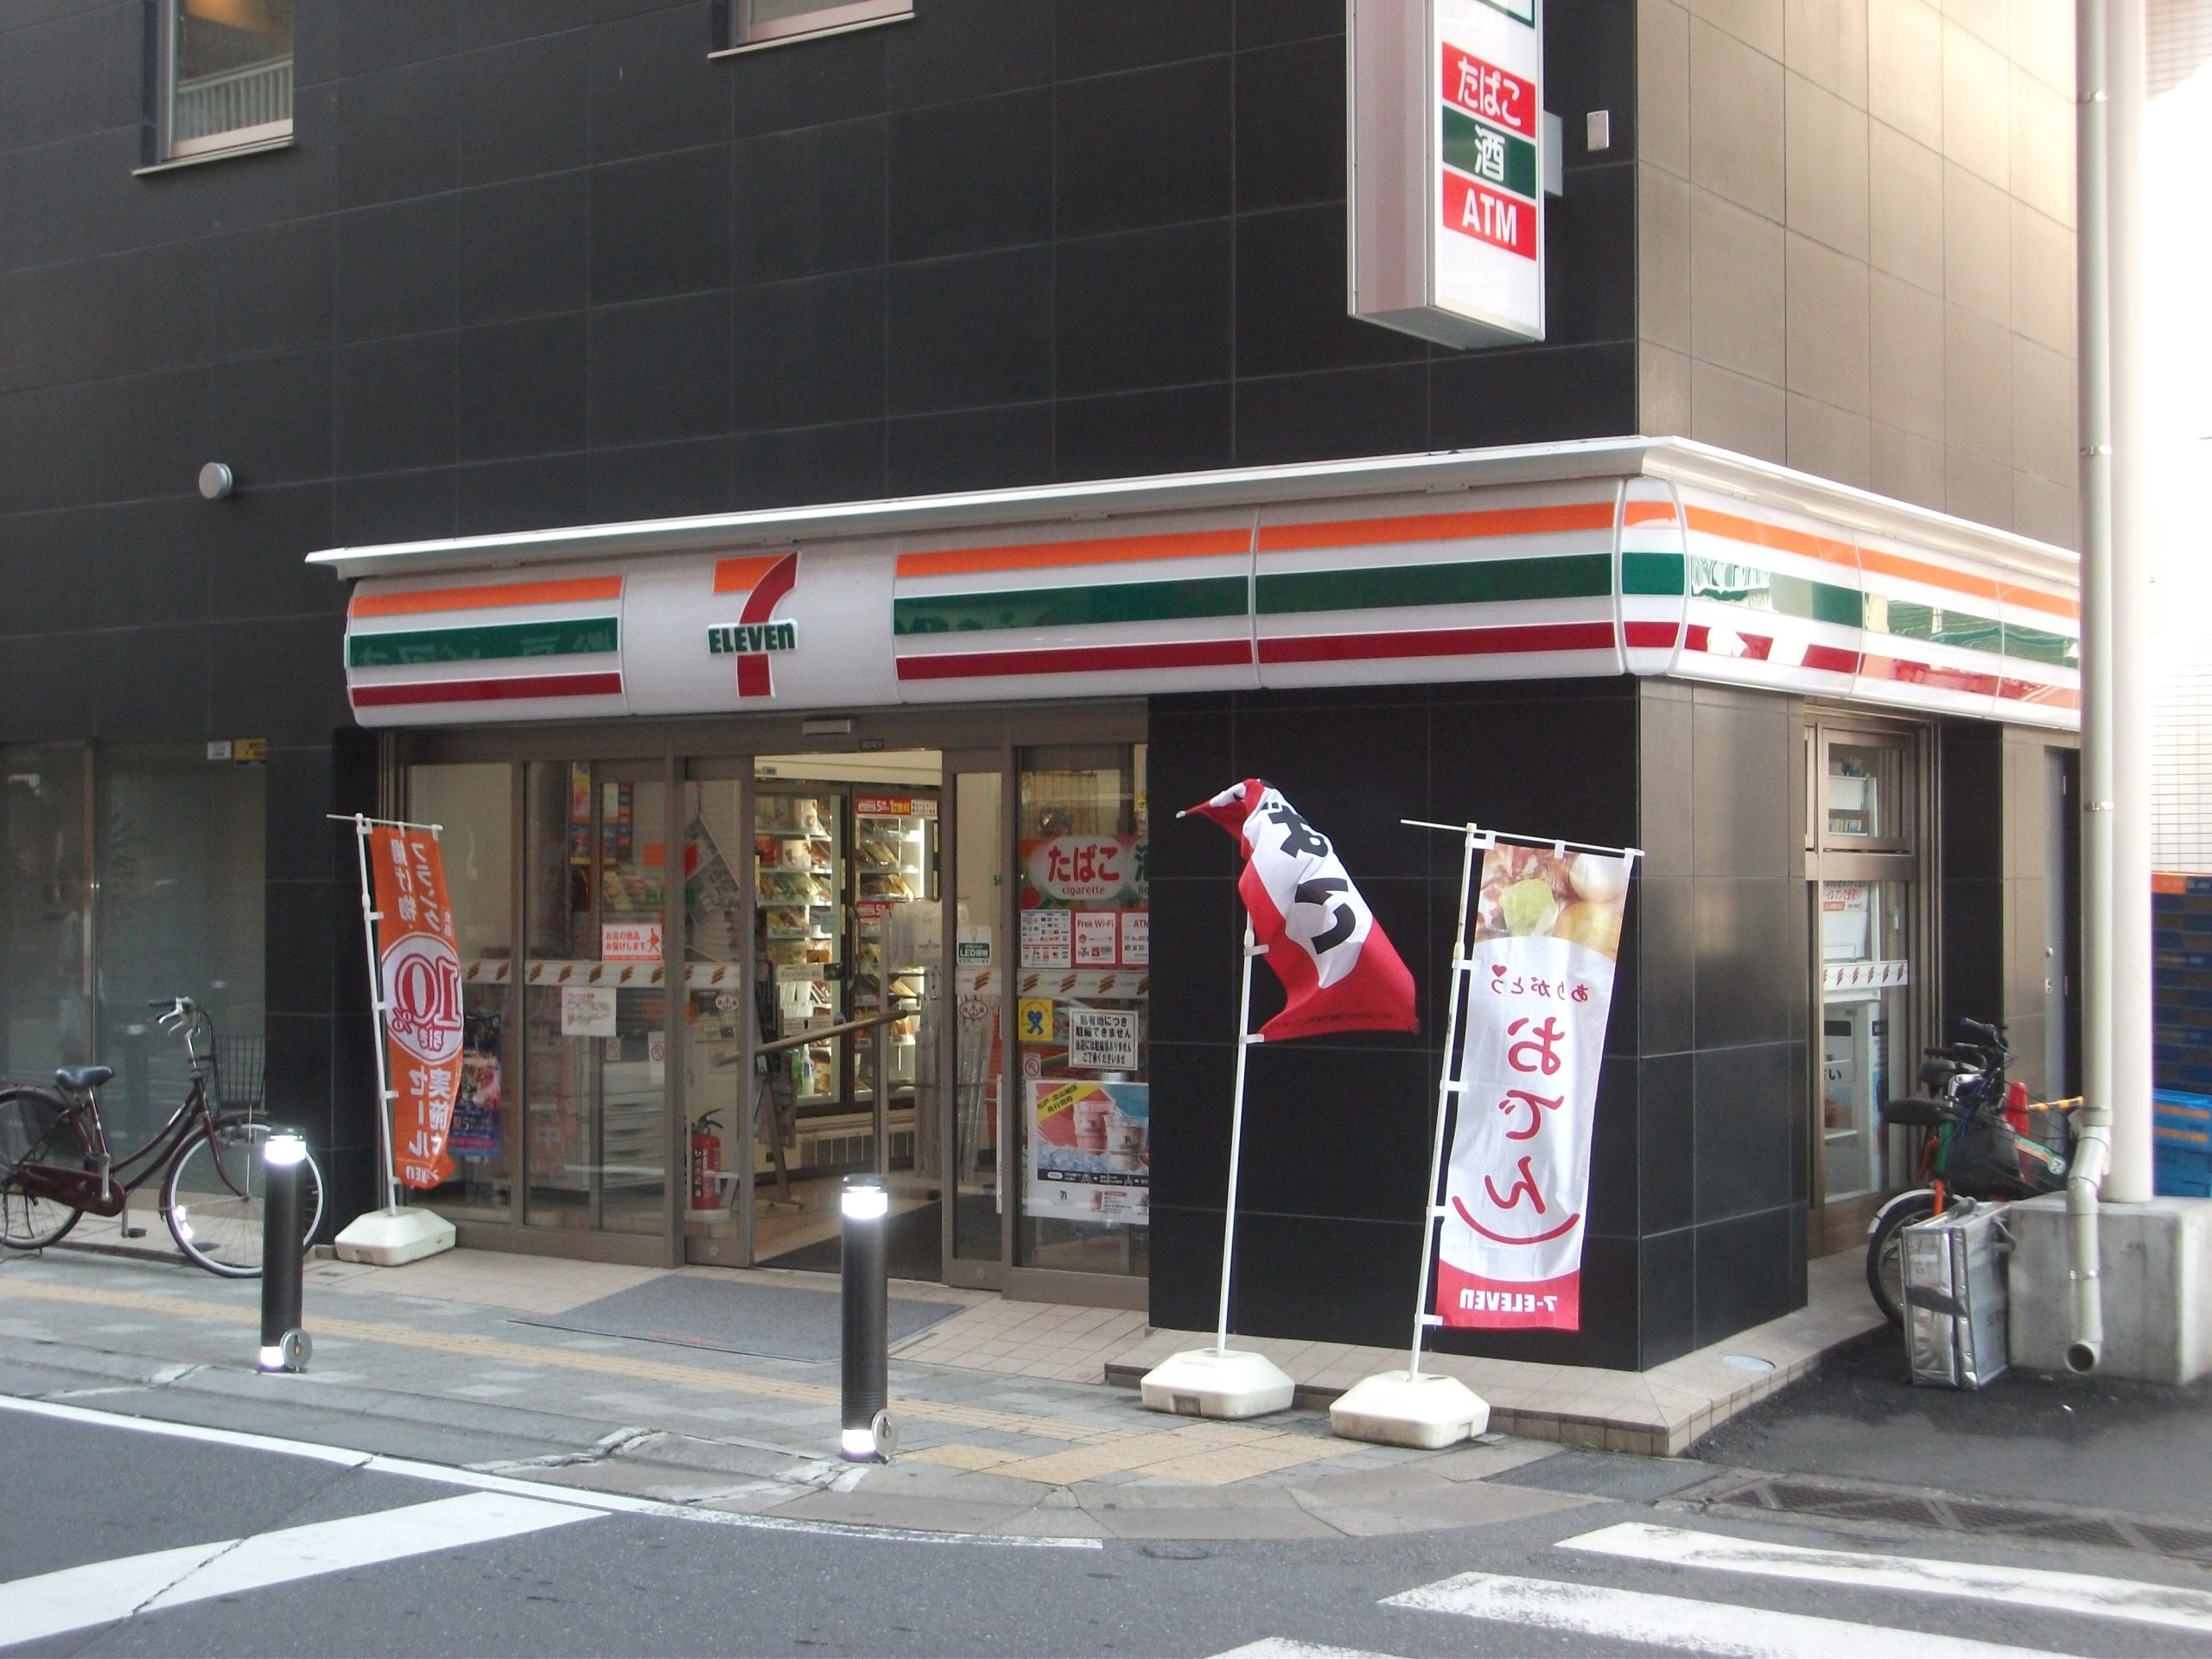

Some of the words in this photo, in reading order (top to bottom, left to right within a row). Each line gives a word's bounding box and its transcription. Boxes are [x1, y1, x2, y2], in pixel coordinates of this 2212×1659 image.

[1458, 55, 1521, 127] たばこ
[1474, 124, 1504, 182] 酒
[1462, 188, 1517, 245] ATM
[1048, 843, 1120, 883] たばこ
[1062, 887, 1105, 896] cigarette
[1077, 919, 1093, 928] Free
[1094, 919, 1114, 928] Wi-Fi
[1080, 1015, 1127, 1027] 私有地につき
